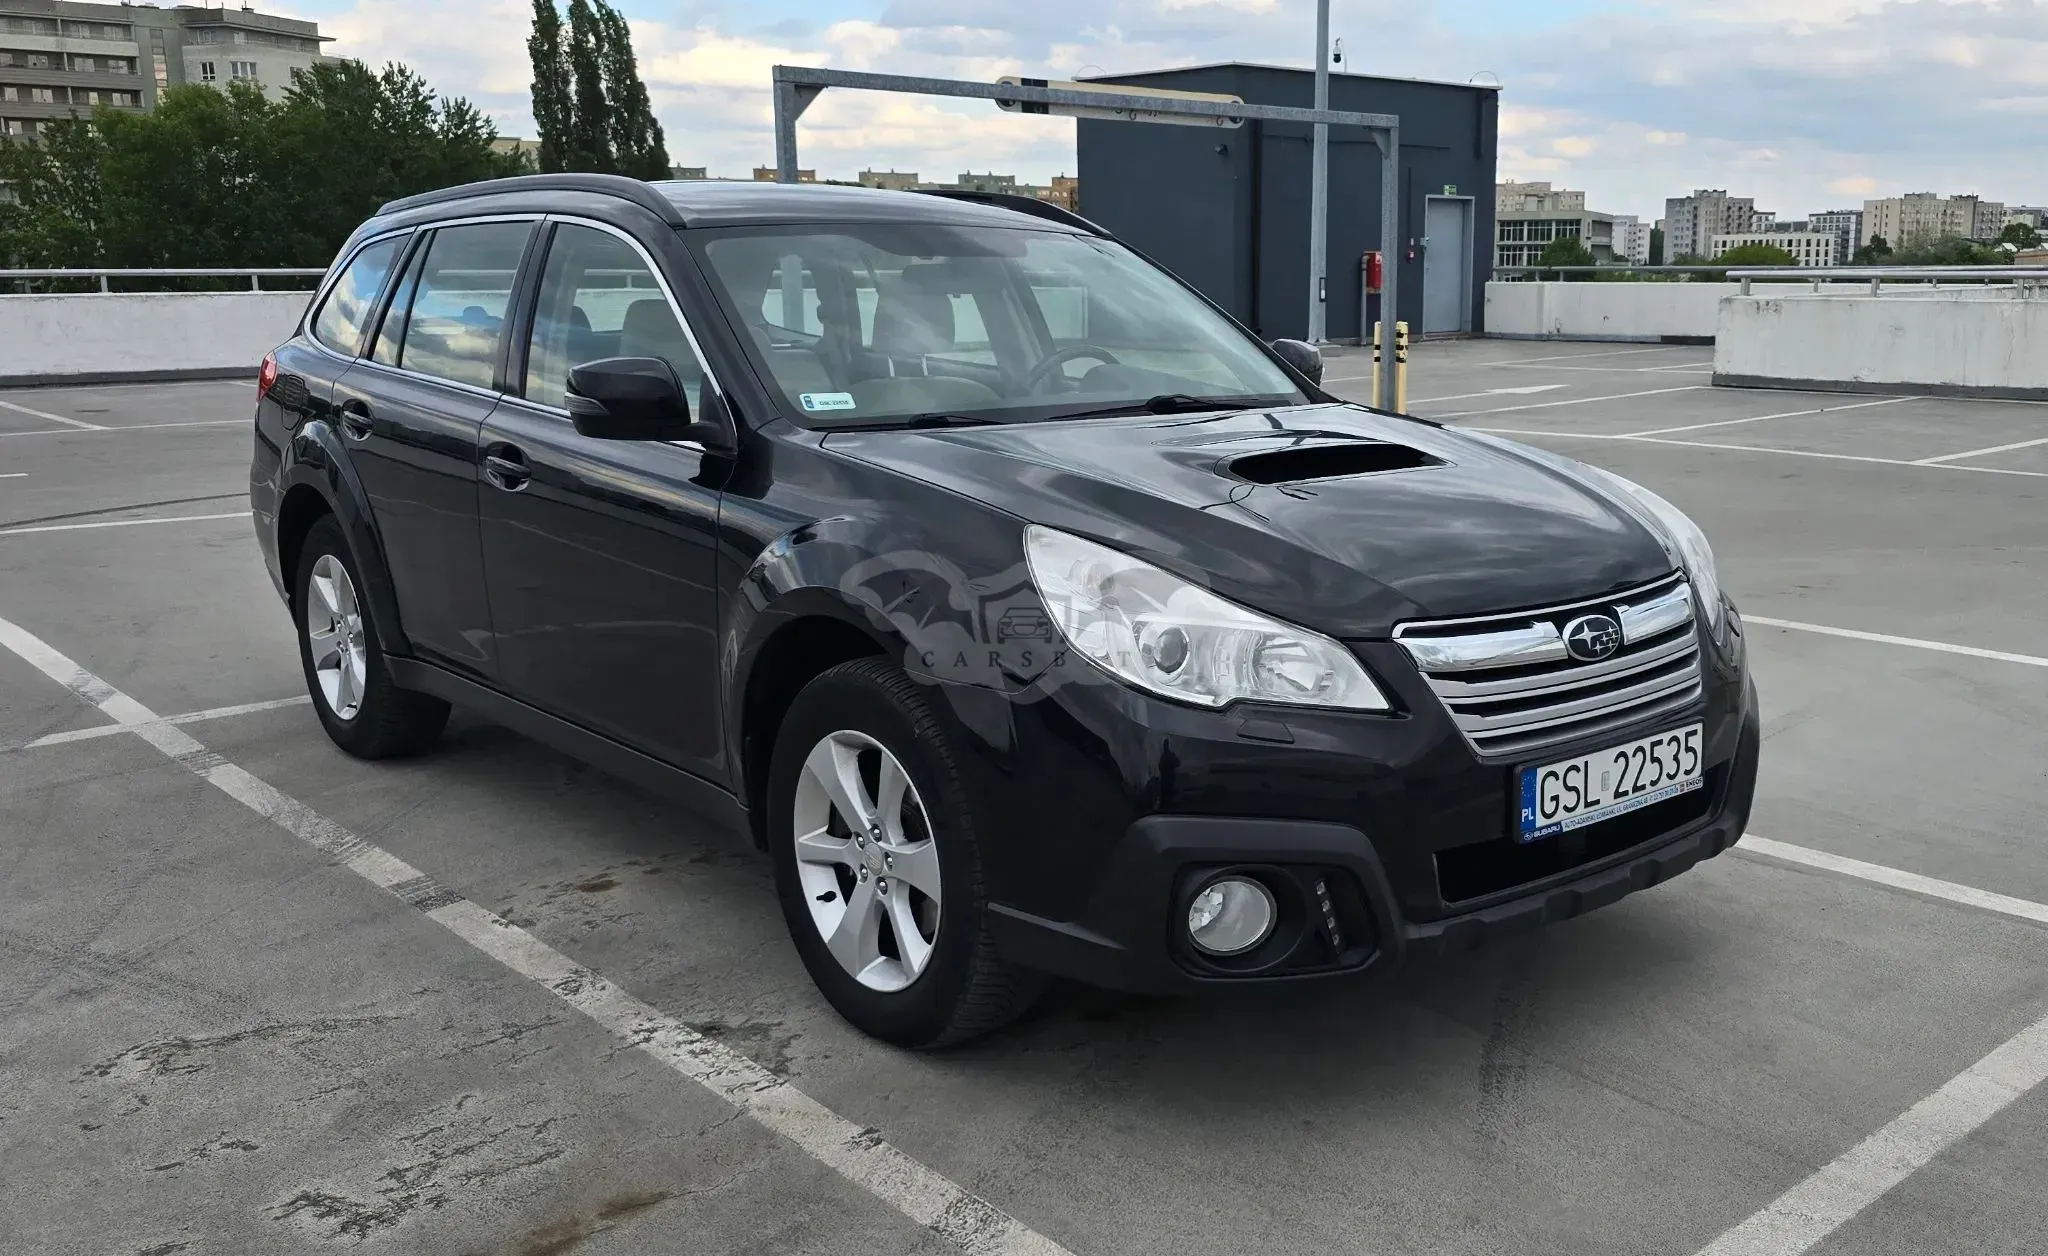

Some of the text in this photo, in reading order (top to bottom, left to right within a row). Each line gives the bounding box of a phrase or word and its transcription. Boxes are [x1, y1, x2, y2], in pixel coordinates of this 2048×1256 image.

[1540, 729, 1698, 820] GSL 22535
[1686, 777, 1703, 788] ENEOS
[1521, 807, 1534, 822] PL
[1533, 824, 1561, 838] SUBARU
